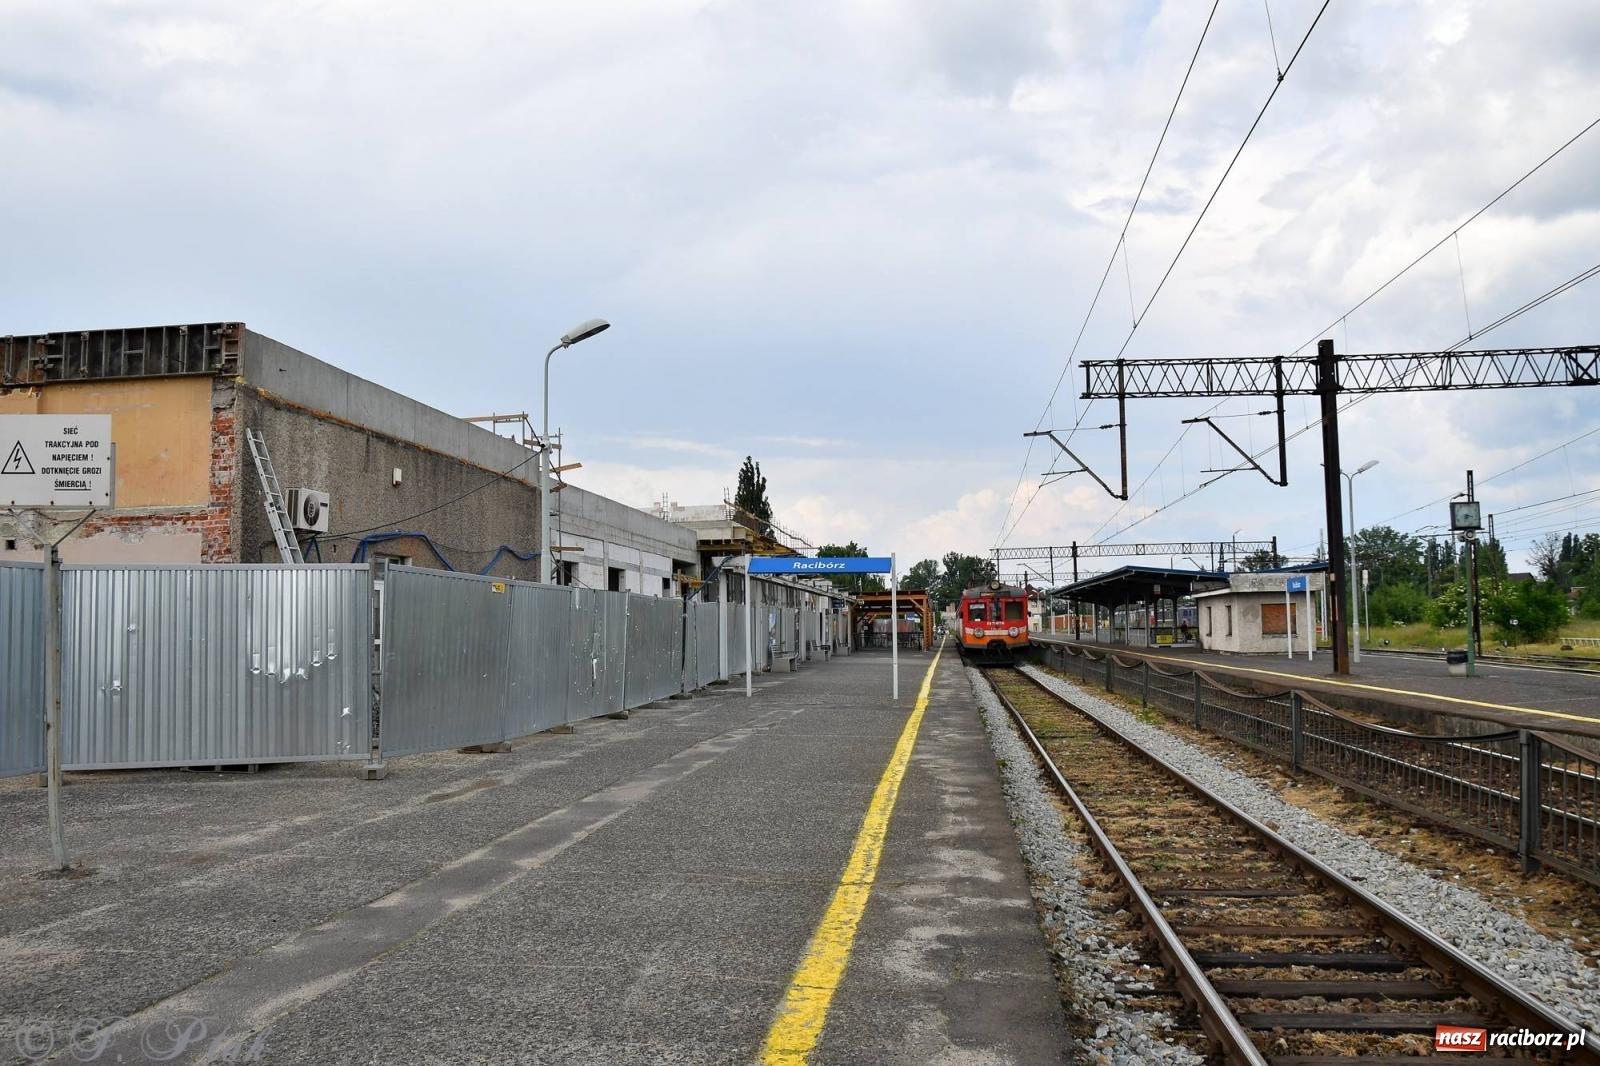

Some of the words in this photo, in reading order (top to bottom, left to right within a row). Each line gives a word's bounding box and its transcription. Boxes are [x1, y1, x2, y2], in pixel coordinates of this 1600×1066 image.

[63, 425, 79, 435] SIEĆ
[45, 440, 83, 448] TRAKCYJNA
[85, 440, 99, 448] POD
[52, 453, 89, 462] NAPIĘCIEM
[41, 467, 80, 476] DOTKNIĘCIE
[82, 467, 102, 475] GROZI
[54, 479, 87, 490] ŚMIERCIĄ
[793, 561, 846, 569] Racibórz
